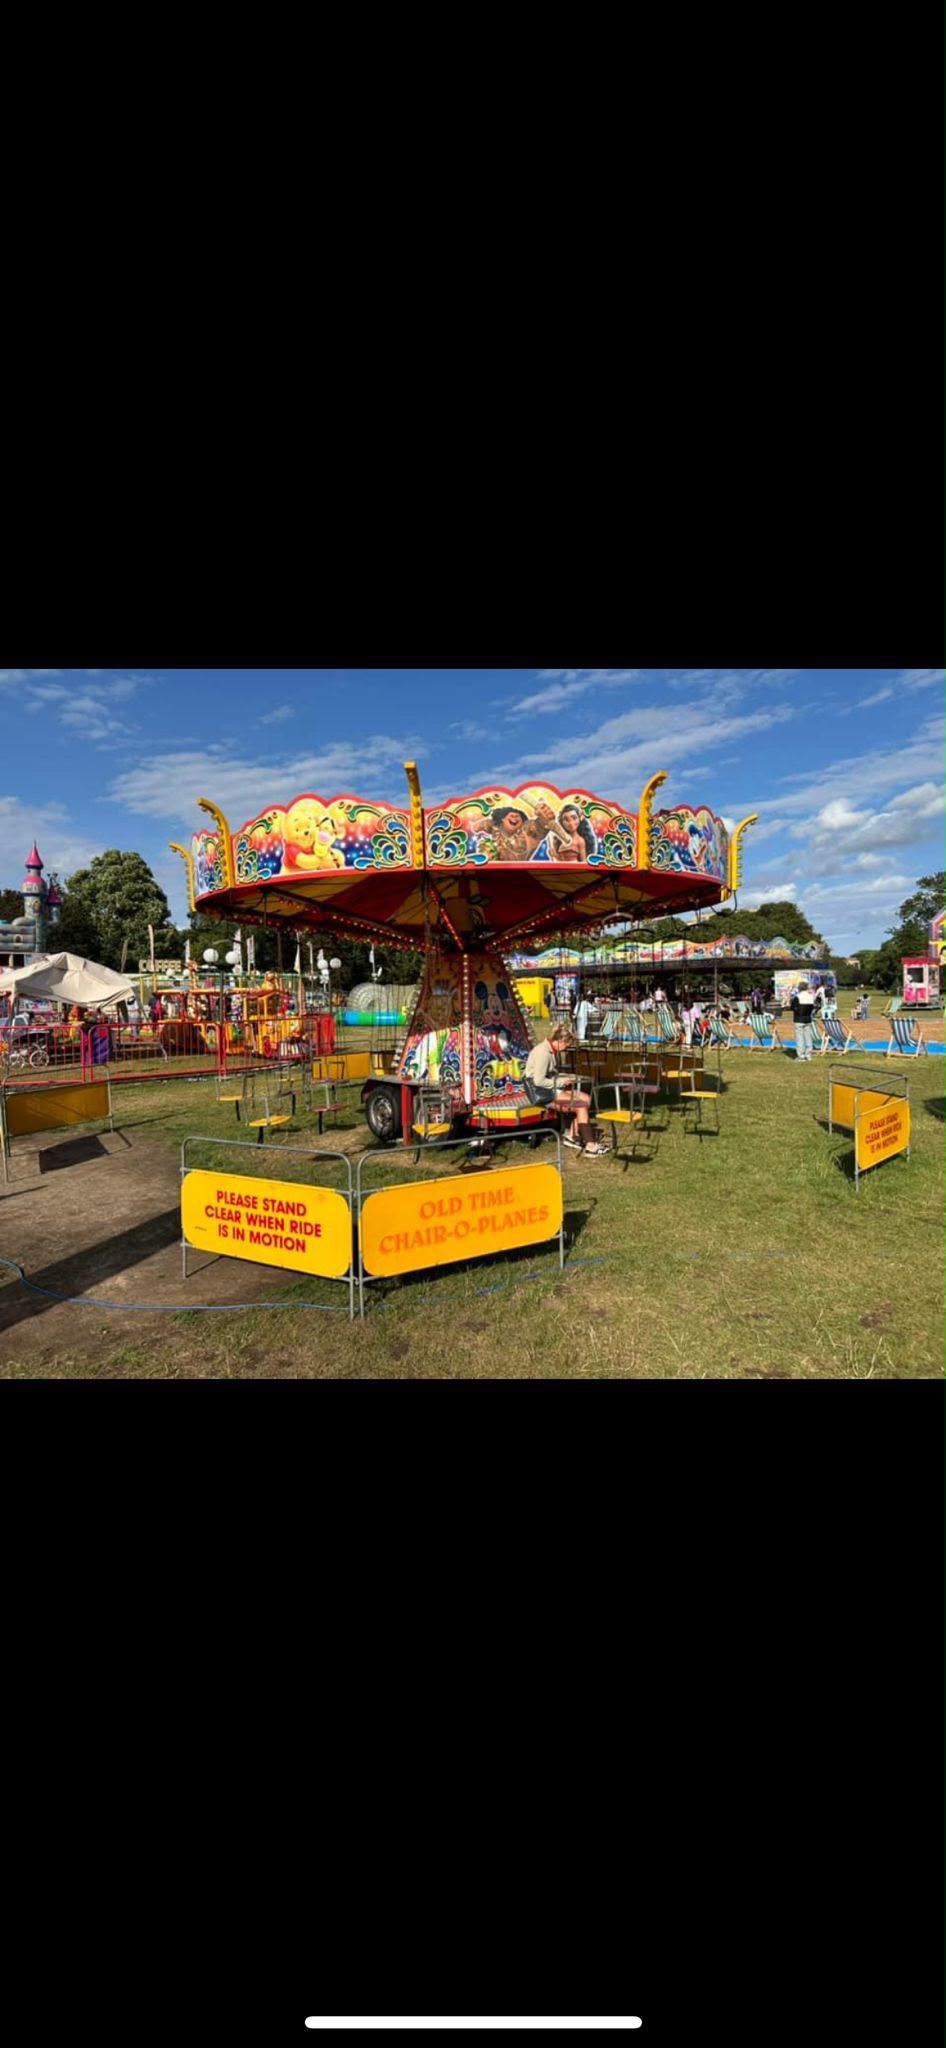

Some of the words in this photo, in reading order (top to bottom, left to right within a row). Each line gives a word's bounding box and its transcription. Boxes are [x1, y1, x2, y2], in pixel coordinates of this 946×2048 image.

[216, 1190, 258, 1209] PLEASE
[262, 1198, 307, 1217] STAND
[419, 1196, 463, 1220] OLD
[468, 1186, 515, 1211] TIME
[204, 1205, 242, 1223] CLEAR
[246, 1212, 285, 1231] WHEN
[290, 1220, 322, 1238] RIDE
[218, 1223, 229, 1238] IS
[232, 1227, 245, 1242] IN
[249, 1230, 306, 1252] MOTION
[378, 1205, 549, 1255] CHAIR-O-PLANES
